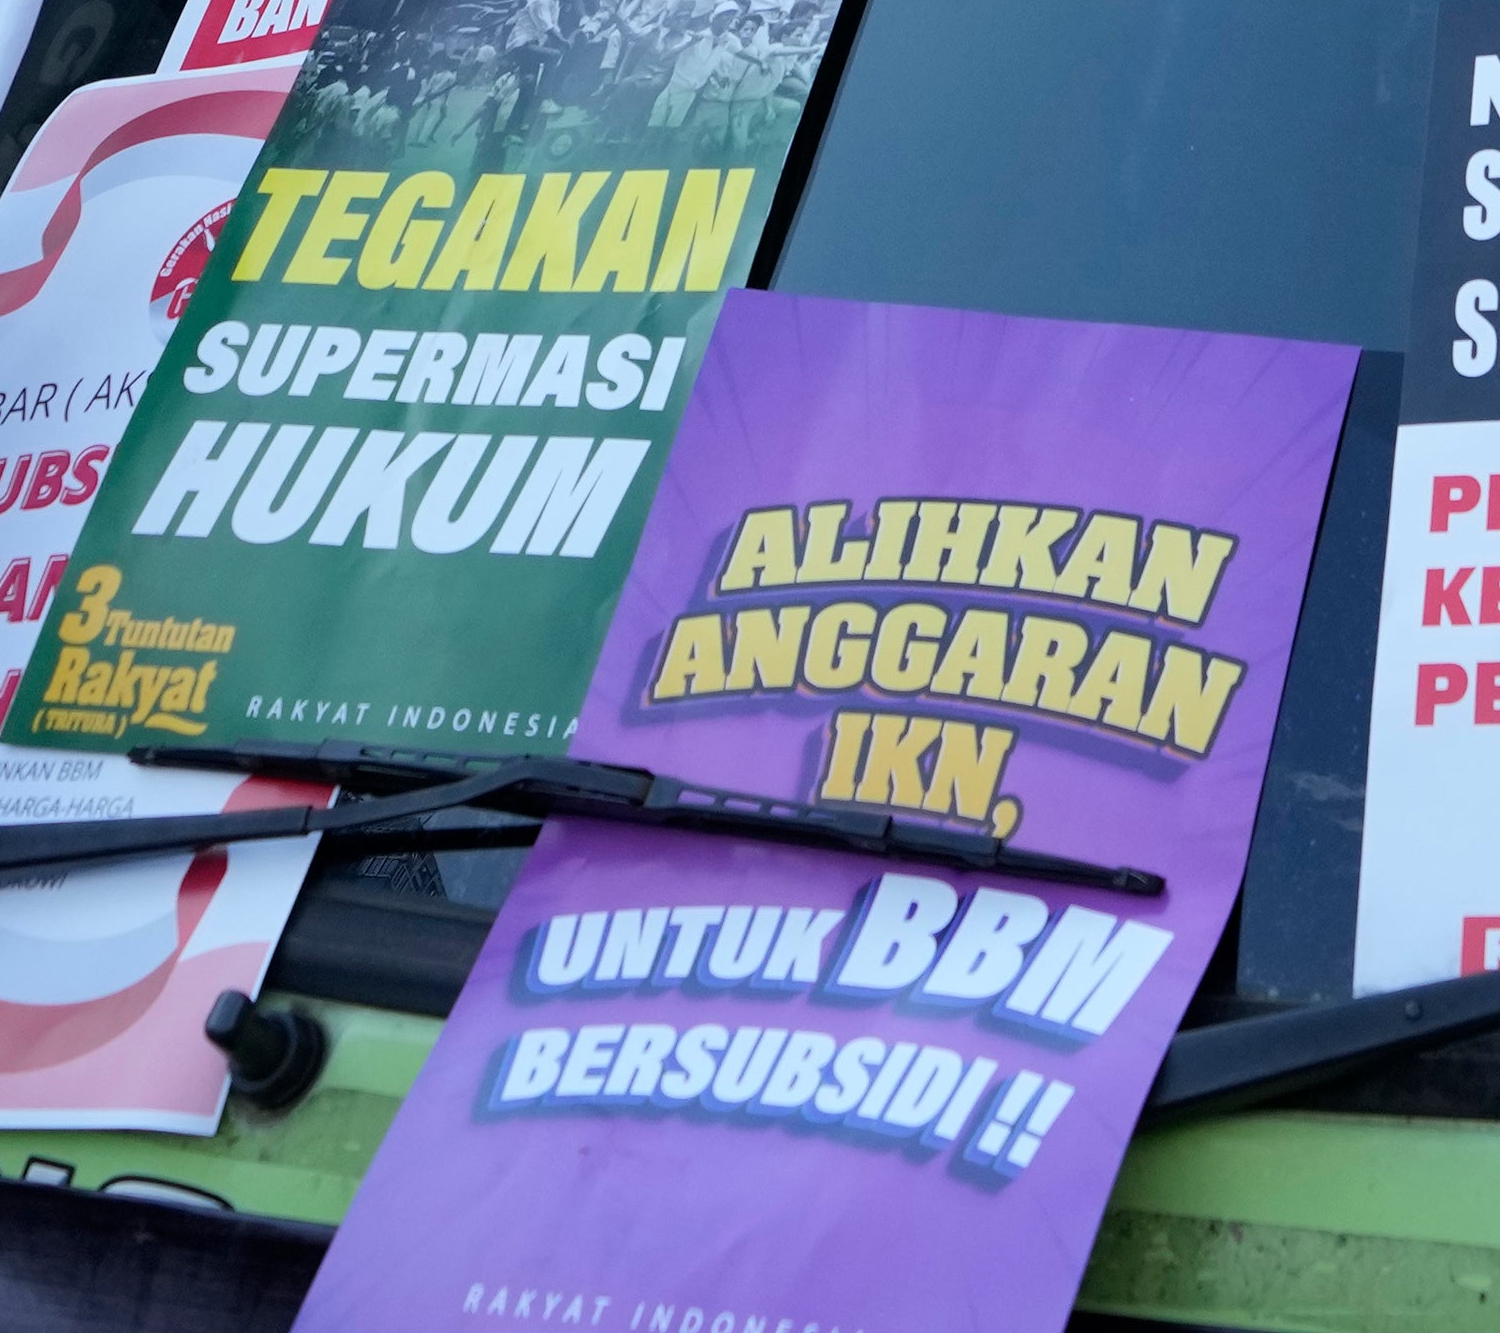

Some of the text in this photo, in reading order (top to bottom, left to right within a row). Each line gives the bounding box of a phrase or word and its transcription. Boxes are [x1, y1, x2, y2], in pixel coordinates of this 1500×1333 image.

[232, 166, 755, 294] TEGAKAN
[183, 320, 687, 412] SUPERMASI
[132, 420, 651, 560] HUKUM
[57, 564, 237, 653] 3 Tuntutan
[715, 498, 1236, 626] ALIHKAN
[43, 645, 218, 724] Rakyat
[246, 694, 580, 739] RAKYAT INDONESIA
[650, 599, 1248, 758] ANGGARAN
[57, 760, 104, 781] BBM
[819, 712, 1021, 839] IKN,
[534, 873, 1175, 1036] UNTUK BBM
[499, 1023, 999, 1142] BERSUBSIDI
[462, 1281, 865, 1333] RAKYAT INDON
